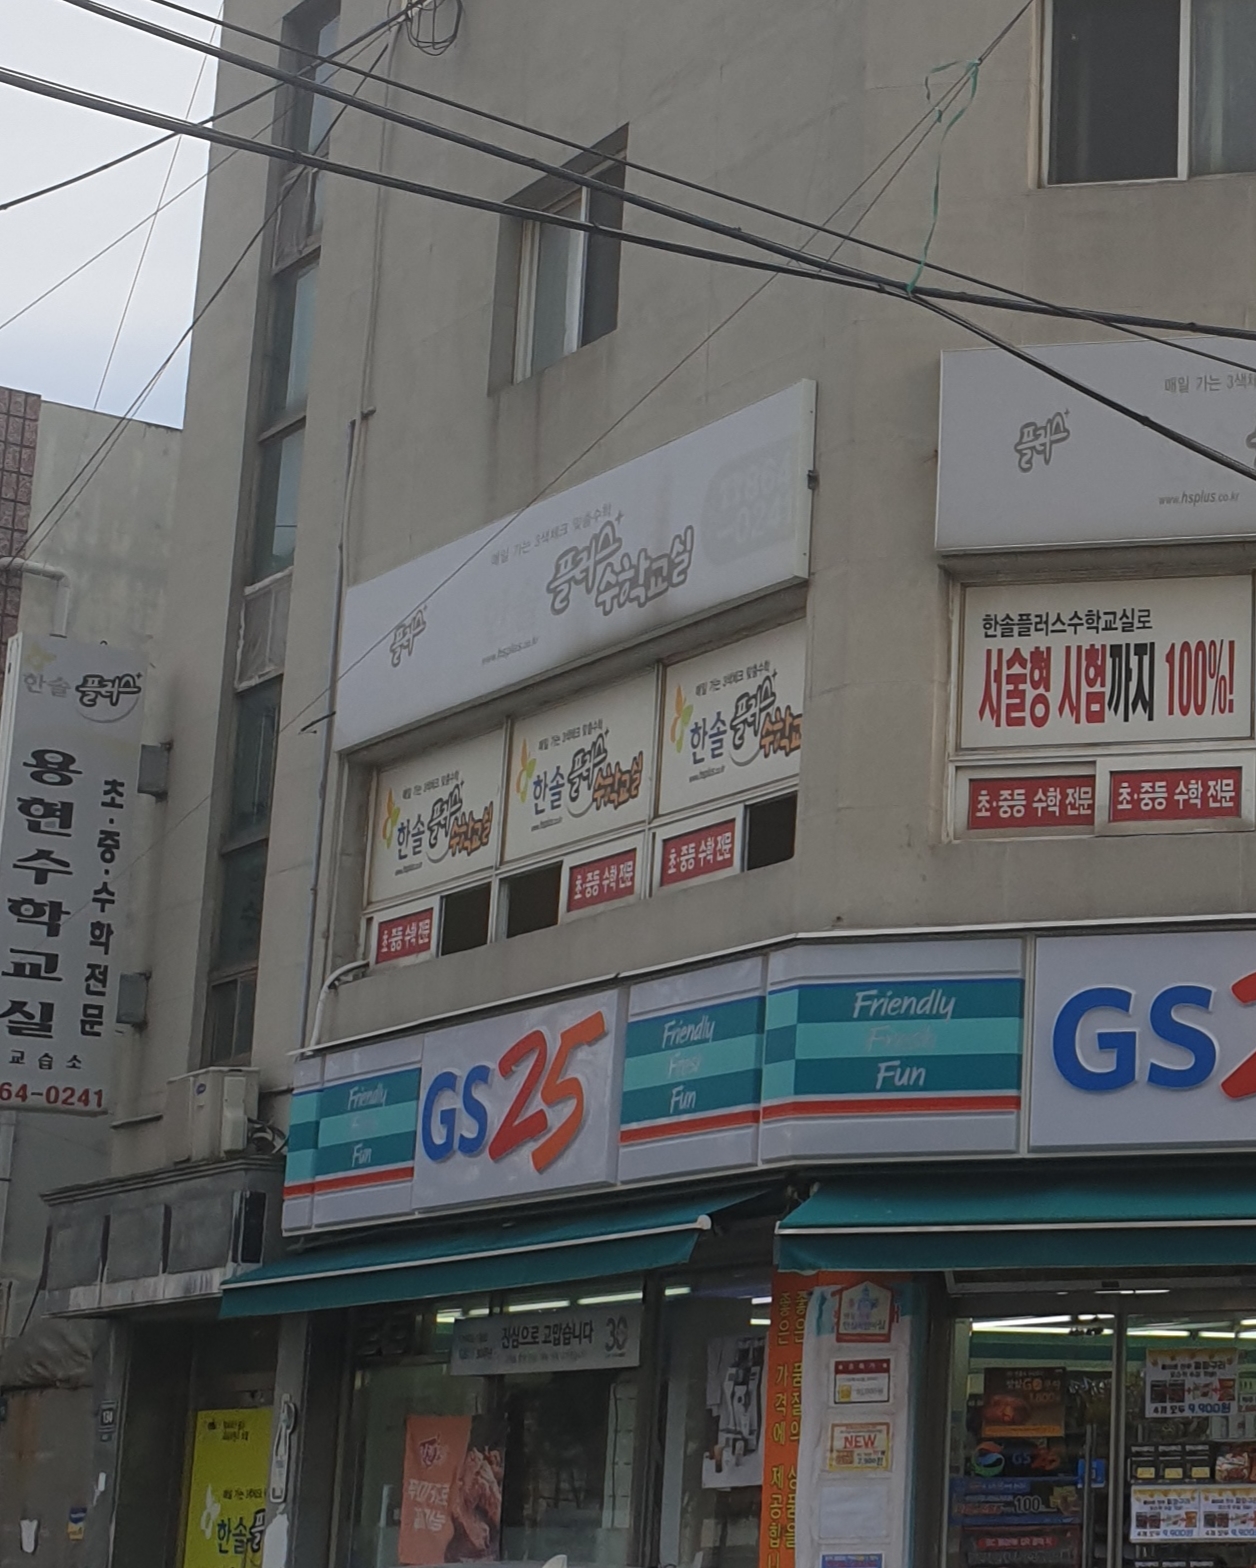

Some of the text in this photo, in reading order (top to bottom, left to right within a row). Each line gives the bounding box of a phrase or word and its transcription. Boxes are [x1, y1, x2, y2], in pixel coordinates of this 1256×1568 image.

[1164, 377, 1190, 394] 매일
[1196, 376, 1220, 392] 가는
[1014, 412, 1070, 473] 플러스
[595, 525, 694, 616] 수학교실
[982, 608, 1152, 638] 한솔플러스수학교실로
[23, 672, 141, 707] 한솔 플러스
[979, 640, 1235, 728] 서술형 시험까지 100%!
[690, 710, 727, 764] 한솔
[533, 765, 565, 815] 한솔
[592, 750, 644, 811] 수학교실
[1117, 779, 1235, 811] 초·중등 수학 전문
[975, 786, 1093, 818] 초·중등 수학 전문
[397, 813, 425, 860] 한솔
[449, 801, 494, 857] 수학교실
[698, 838, 715, 866] 수학
[717, 832, 732, 860] 전문
[0, 749, 83, 1039] 용현수학교실
[602, 865, 617, 893] 수학
[619, 861, 633, 888] 전문
[853, 988, 956, 1024] Friendly
[662, 1015, 716, 1049] Friendly
[421, 1010, 606, 1174] GS25
[876, 1060, 926, 1089] Fun
[670, 1085, 697, 1114] Fun
[352, 1143, 372, 1167] Fun
[502, 1326, 539, 1349] 진심으로
[542, 1320, 594, 1347] 고맙습니다
[773, 1364, 789, 1445] 가격에
[843, 1433, 877, 1449] NEW
[217, 1516, 246, 1554] 한솔
